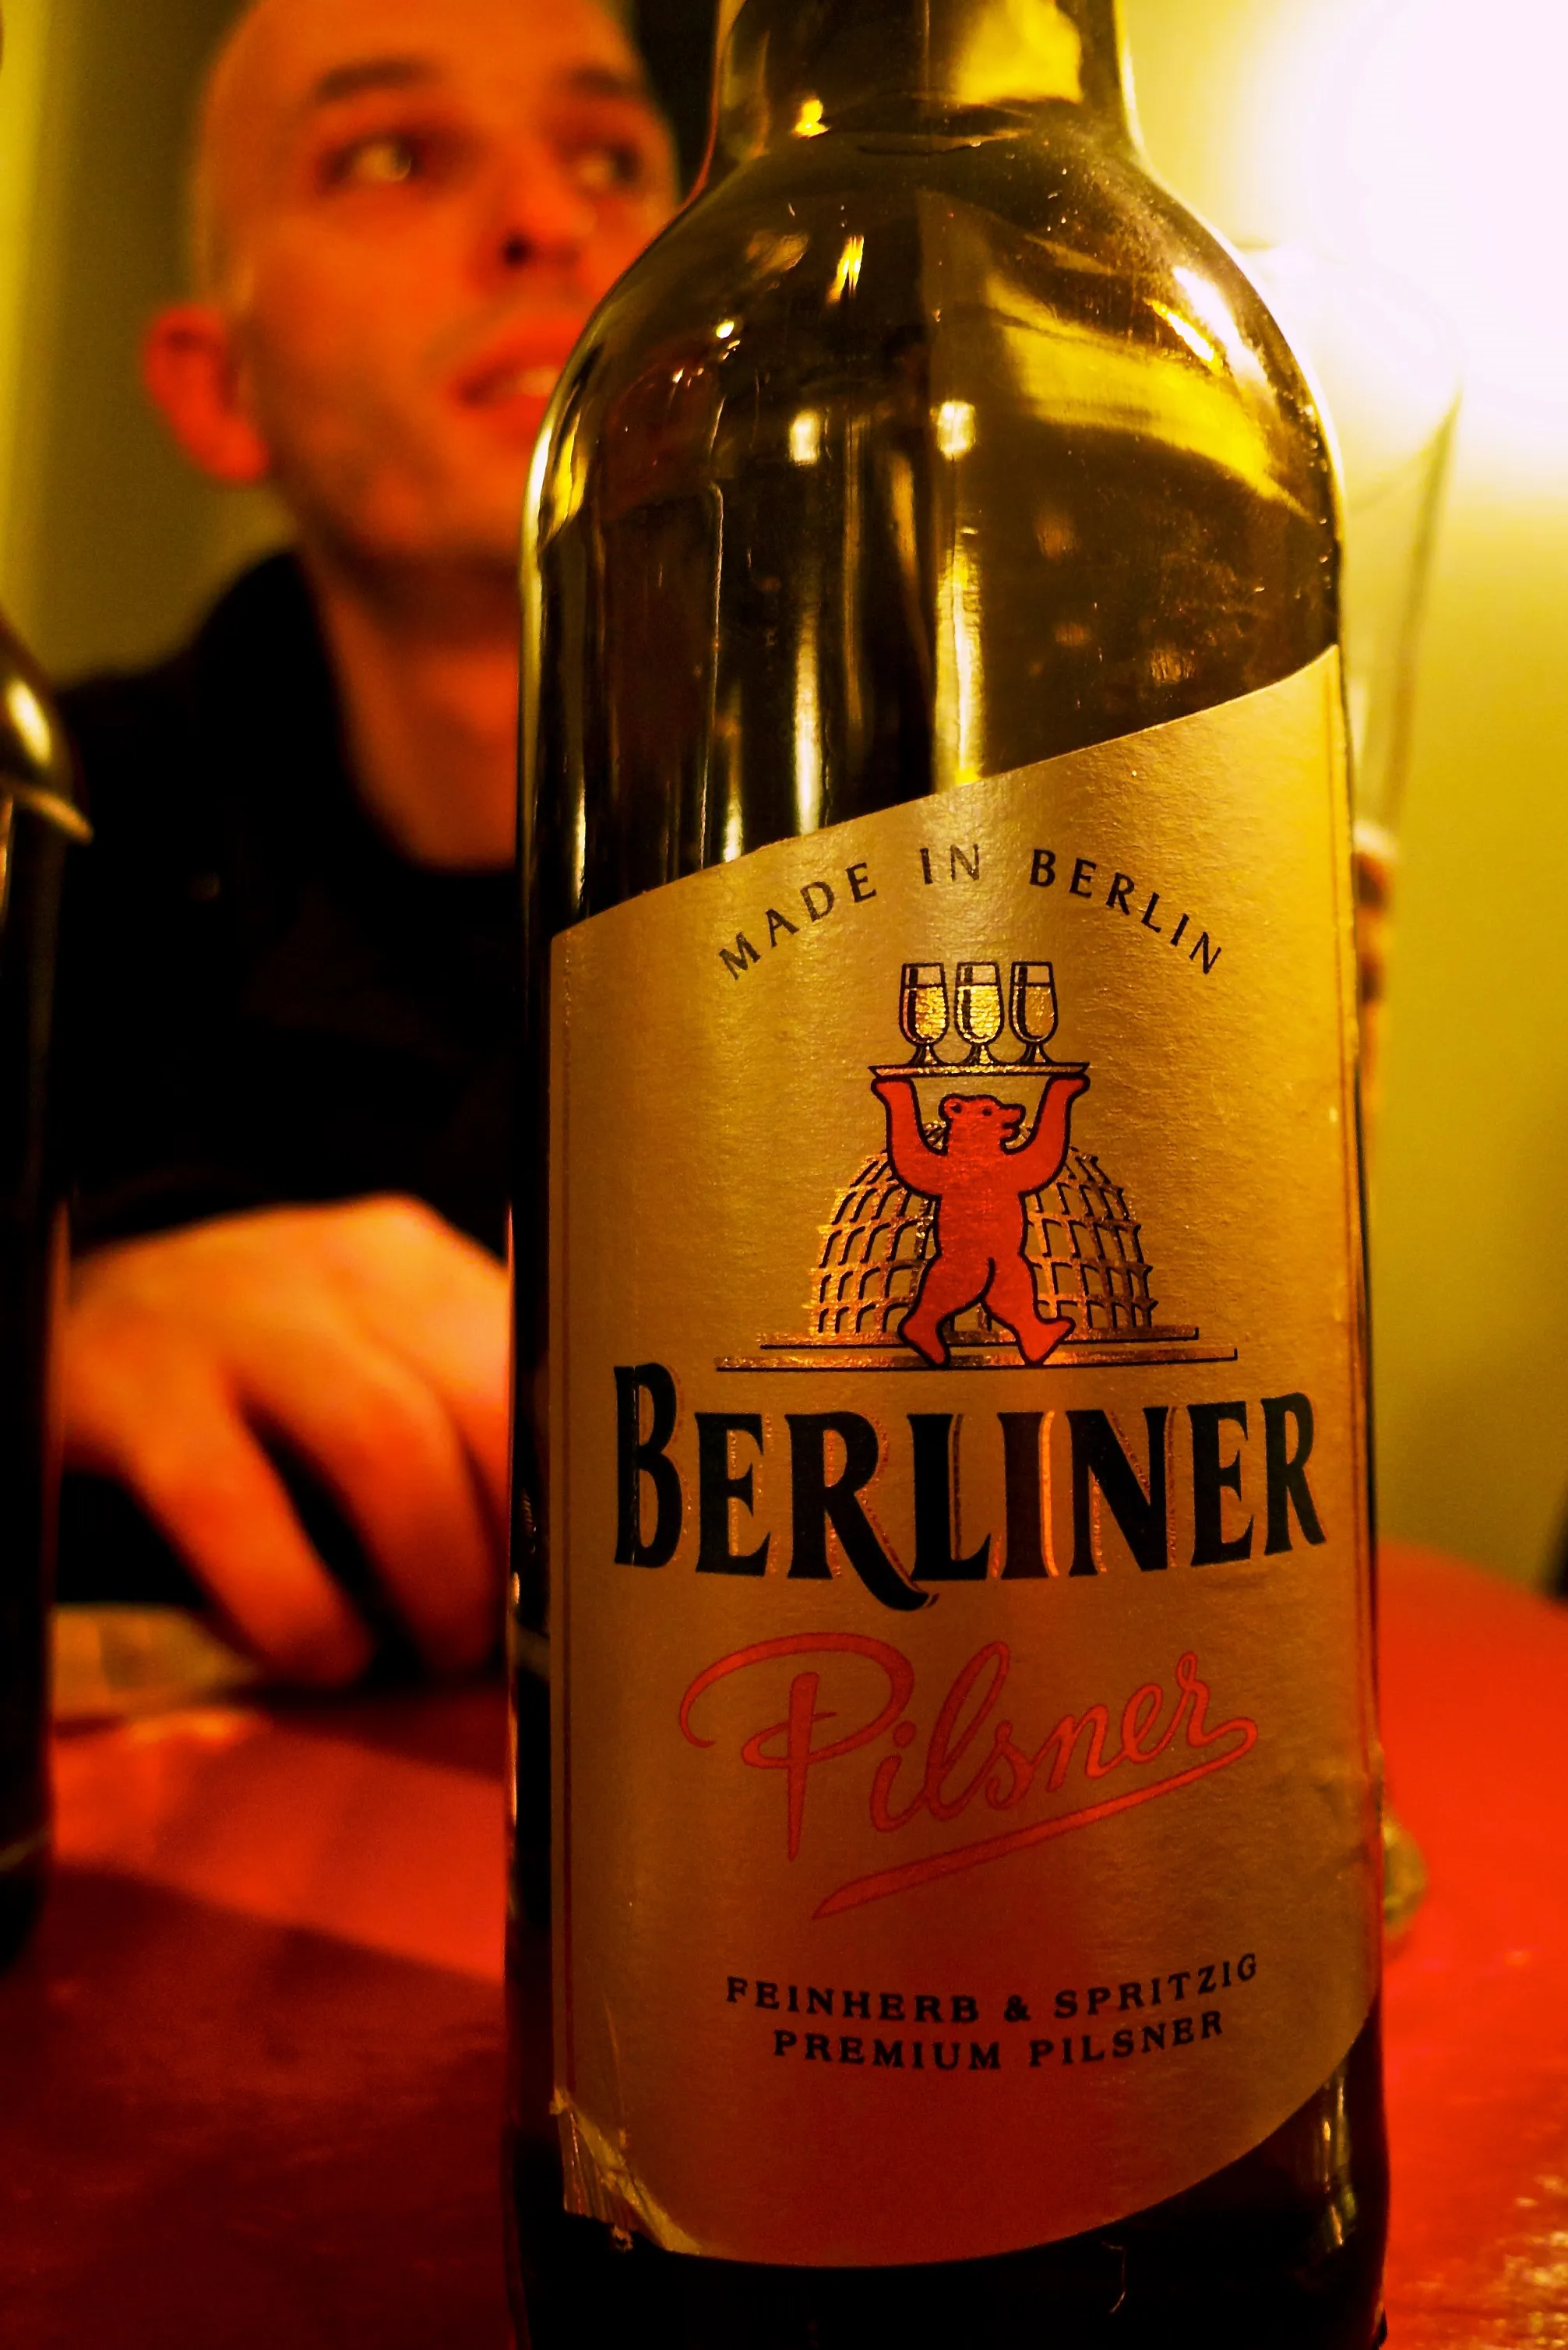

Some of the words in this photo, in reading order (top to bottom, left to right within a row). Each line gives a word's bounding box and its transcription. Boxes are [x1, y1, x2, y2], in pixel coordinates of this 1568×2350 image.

[718, 862, 877, 980] MADE
[920, 844, 980, 885] IN
[1029, 848, 1222, 974] BERLIN
[614, 1362, 1327, 1611] BERLINER
[678, 1632, 1259, 1920] Pilsner
[725, 1976, 979, 2024] FEINHERB
[1003, 1995, 1031, 2023] &
[1054, 1953, 1257, 2020] SPRITZIG
[773, 2029, 1002, 2071] PREMIUM
[1029, 2010, 1224, 2069] PILSNER
